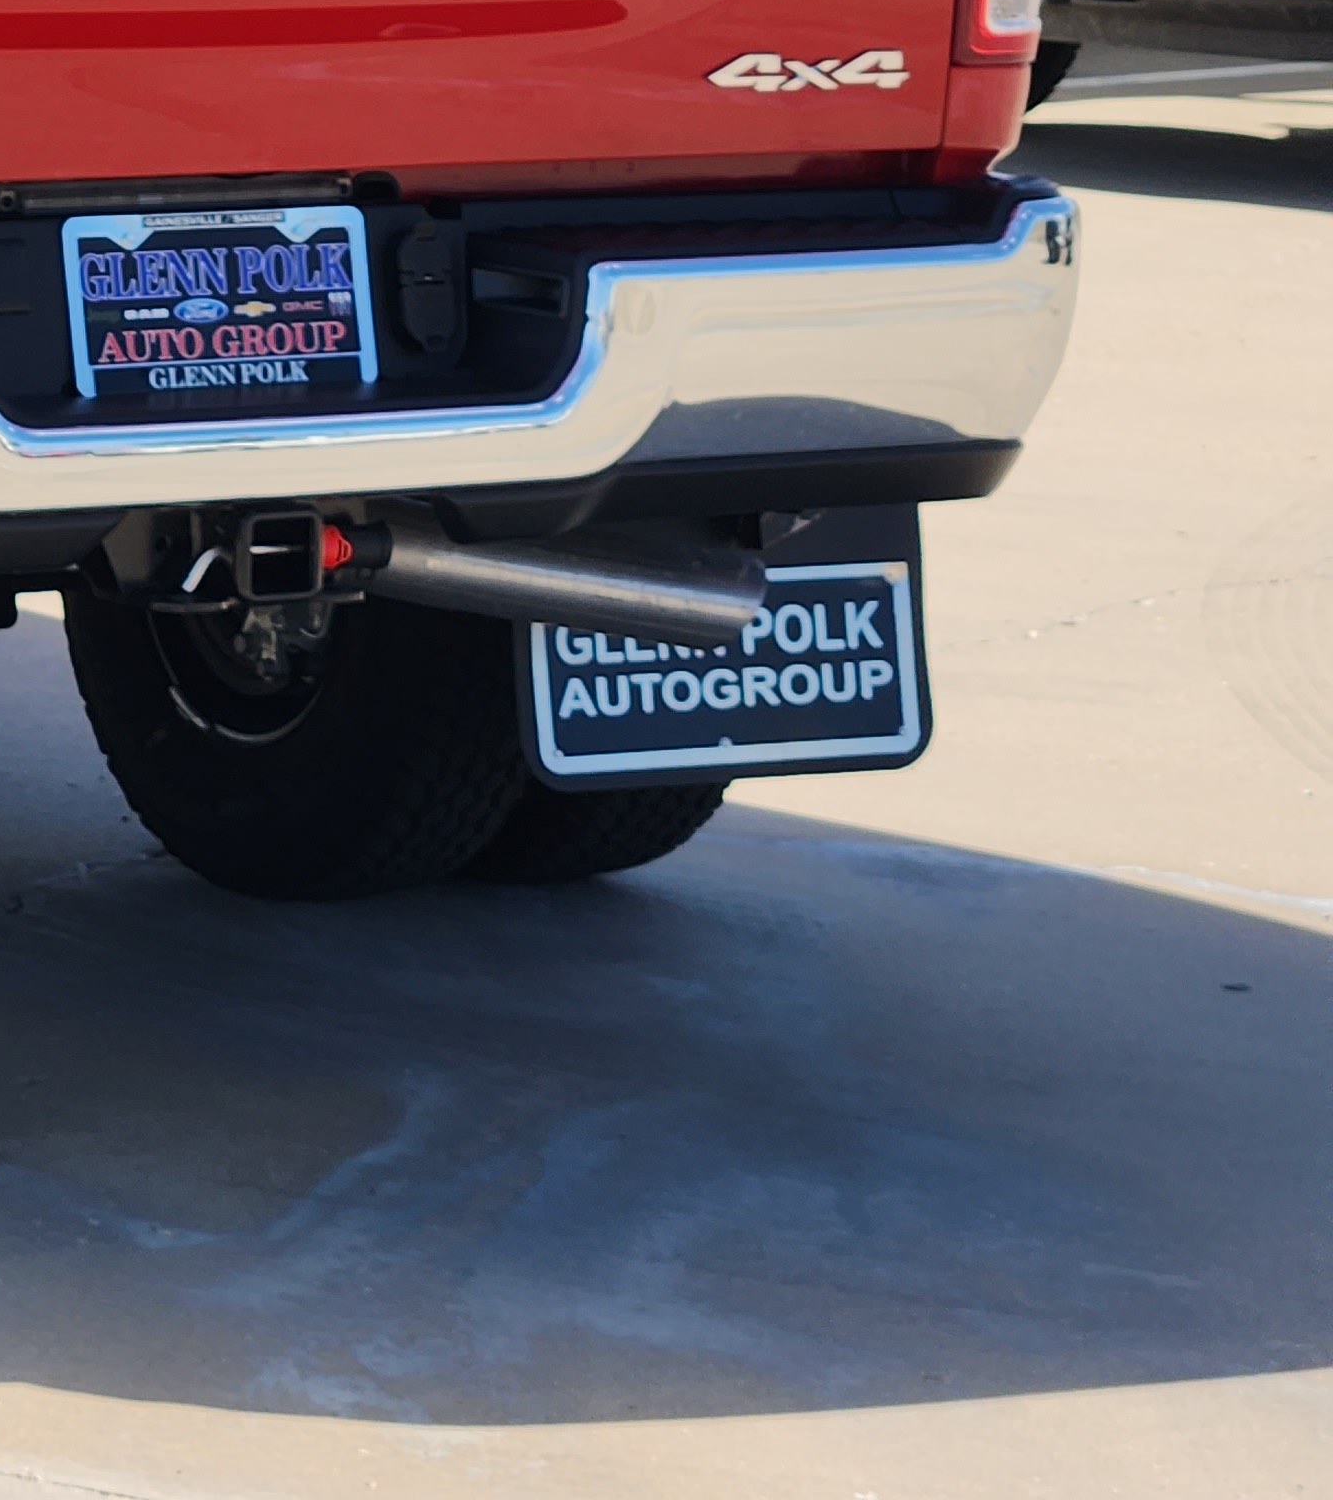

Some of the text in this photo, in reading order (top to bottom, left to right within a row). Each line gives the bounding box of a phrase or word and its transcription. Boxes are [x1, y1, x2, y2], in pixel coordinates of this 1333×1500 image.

[706, 49, 911, 92] 4x4
[80, 243, 353, 301] GLENN POLK
[98, 320, 346, 363] AUTO GROUP
[148, 360, 310, 390] GLENN POLK
[742, 600, 885, 657] POLK
[558, 659, 894, 720] AUTOGROUP
